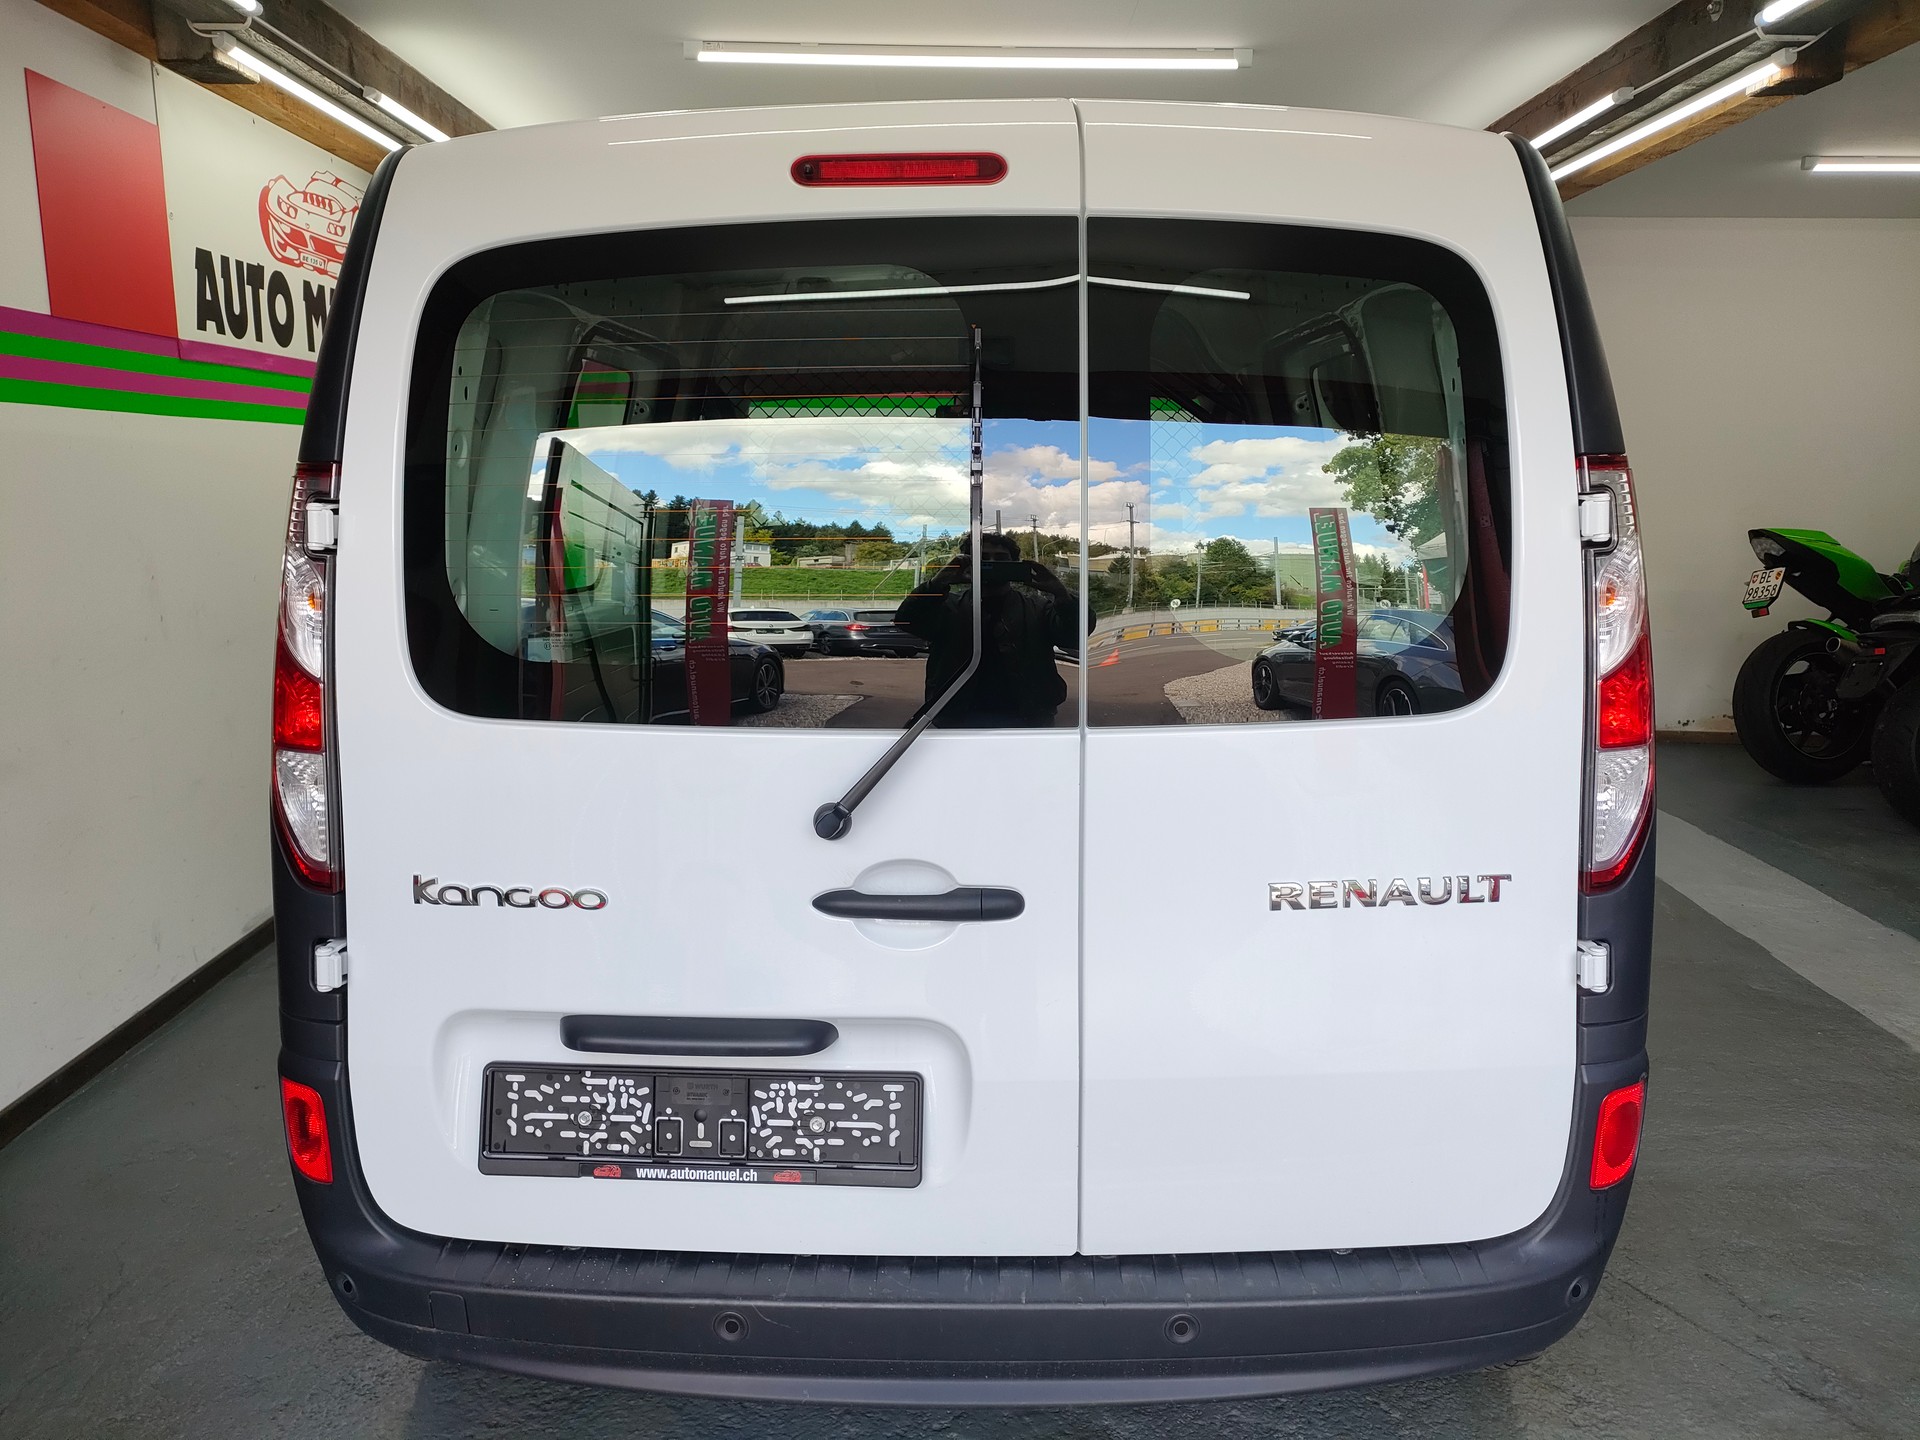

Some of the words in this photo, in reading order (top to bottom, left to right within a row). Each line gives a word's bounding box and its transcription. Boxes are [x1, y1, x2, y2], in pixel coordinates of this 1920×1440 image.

[195, 247, 294, 348] AUTO
[303, 279, 335, 353] M
[1759, 570, 1774, 584] BE
[1747, 584, 1778, 599] 98358
[1268, 874, 1512, 912] RENAULT
[636, 1167, 758, 1181] www.automanuel.ch
